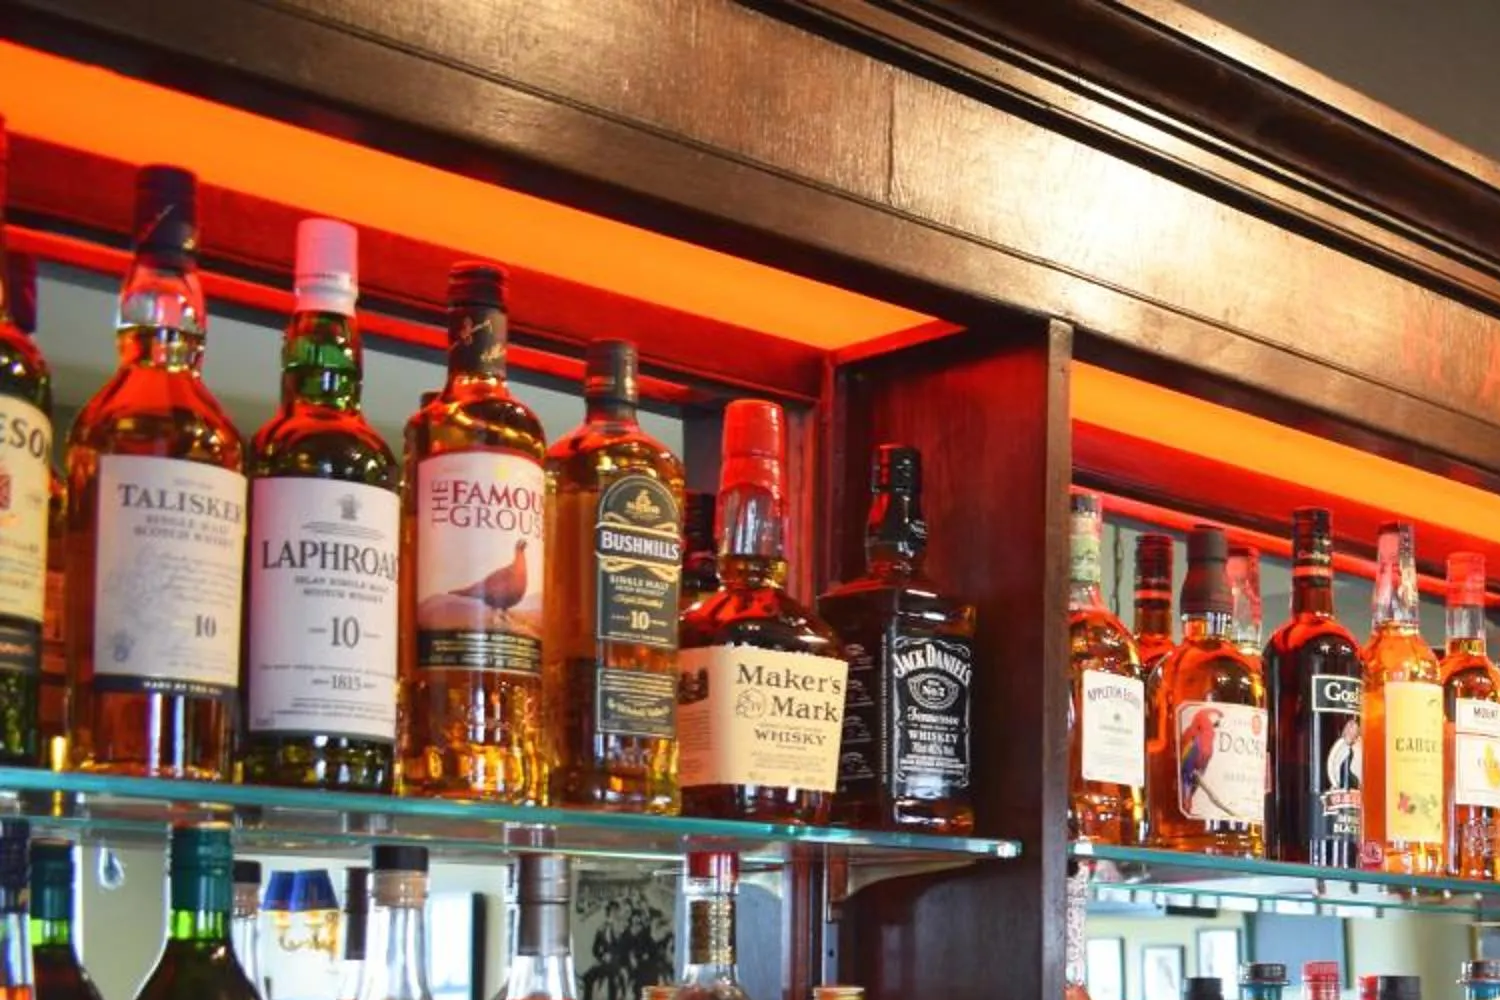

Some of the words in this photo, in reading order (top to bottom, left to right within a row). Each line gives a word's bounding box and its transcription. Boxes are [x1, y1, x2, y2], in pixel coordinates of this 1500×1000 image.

[117, 483, 241, 523] TALISKE
[431, 479, 450, 526] THE
[450, 480, 544, 514] FAMOU
[448, 504, 542, 539] GROUS
[601, 530, 681, 561] BUSHMILLS
[195, 615, 216, 638] 10
[331, 616, 361, 649] 10
[630, 610, 651, 631] 10
[736, 663, 842, 695] Maker's
[893, 650, 926, 678] JACK
[925, 643, 973, 687] DANIEL'S
[769, 695, 839, 723] Mark
[754, 728, 828, 747] WHISKY
[908, 730, 959, 744] WHISKEY
